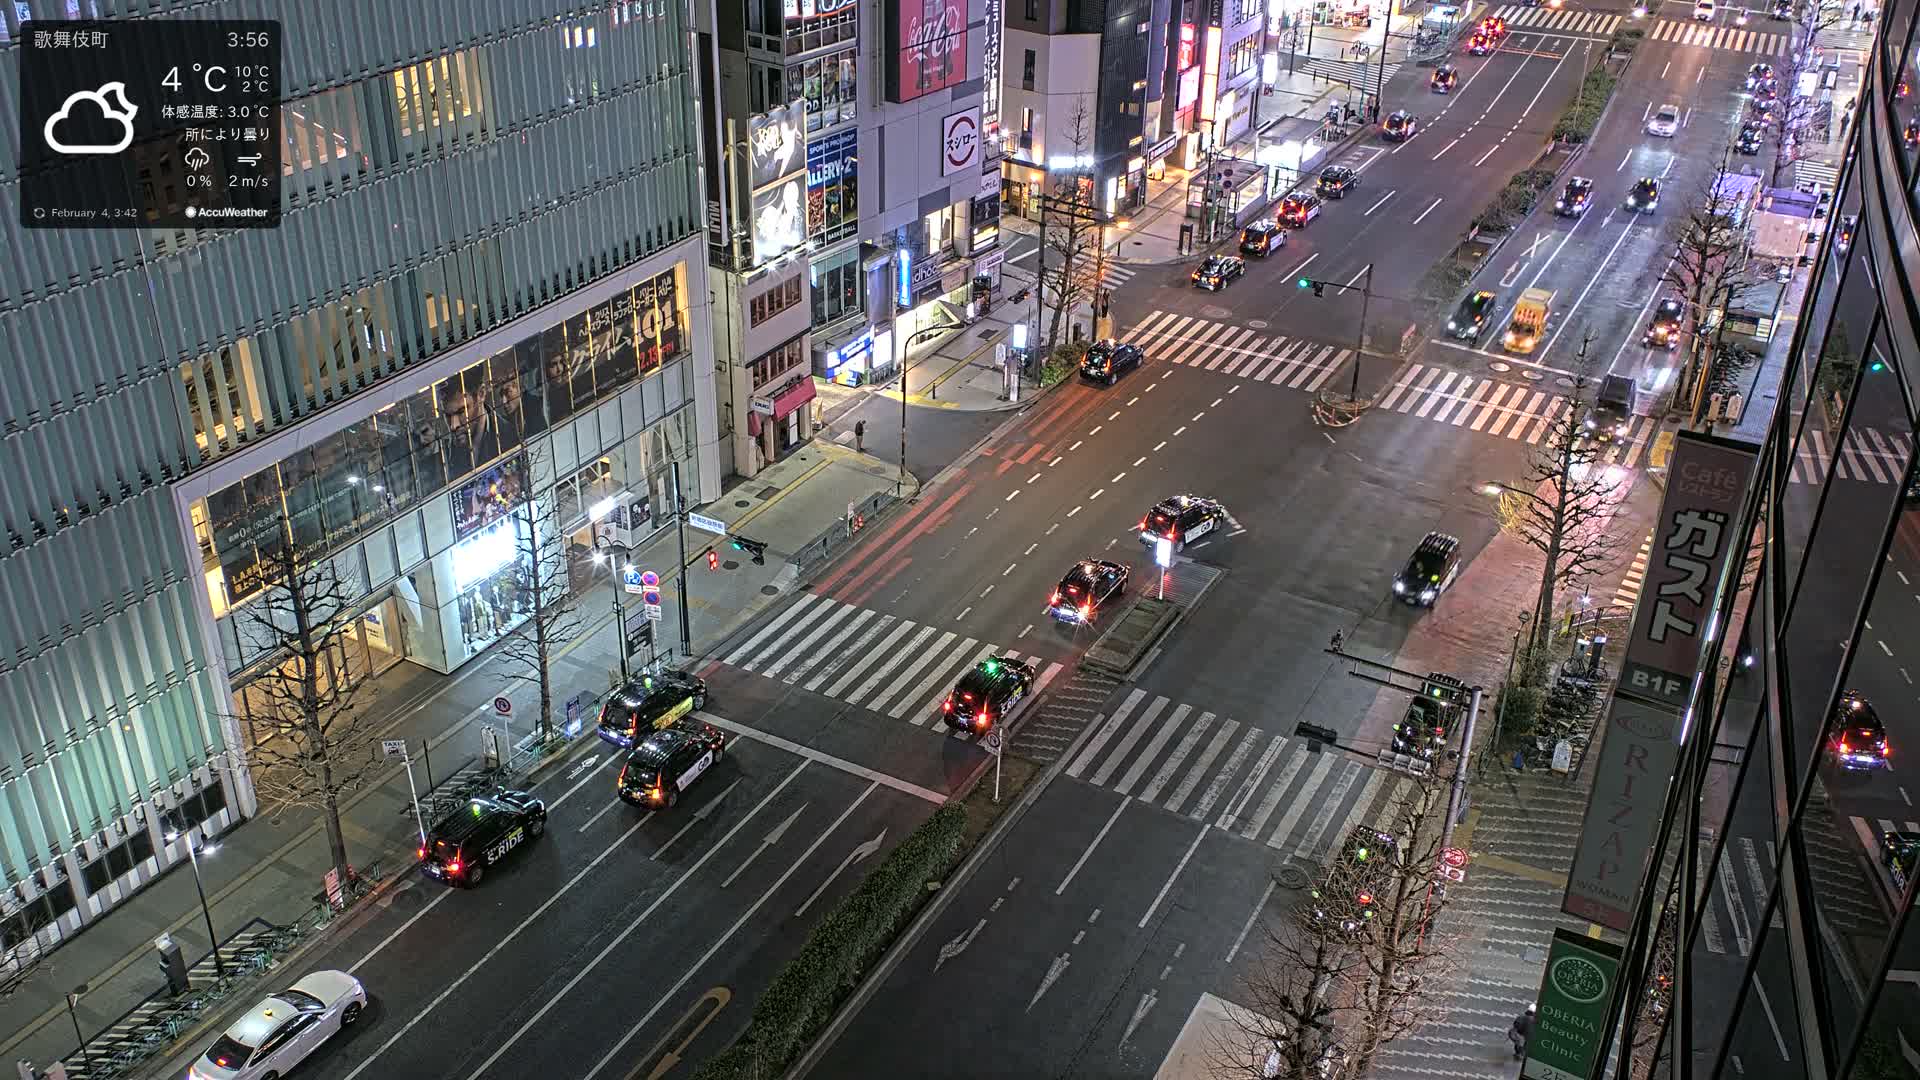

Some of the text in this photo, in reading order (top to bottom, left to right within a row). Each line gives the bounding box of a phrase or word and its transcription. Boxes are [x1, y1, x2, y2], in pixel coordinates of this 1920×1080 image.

[946, 133, 977, 153] スシロー
[708, 200, 721, 234] MUJI
[1648, 510, 1725, 641] ガスト
[1631, 671, 1681, 696] B1F
[1596, 743, 1649, 881] RIZAP
[487, 830, 525, 865] S.RIDE
[1540, 1019, 1590, 1048] Beauty
[1541, 1005, 1596, 1033] OBERIA
[1540, 1038, 1583, 1062] Clinic
